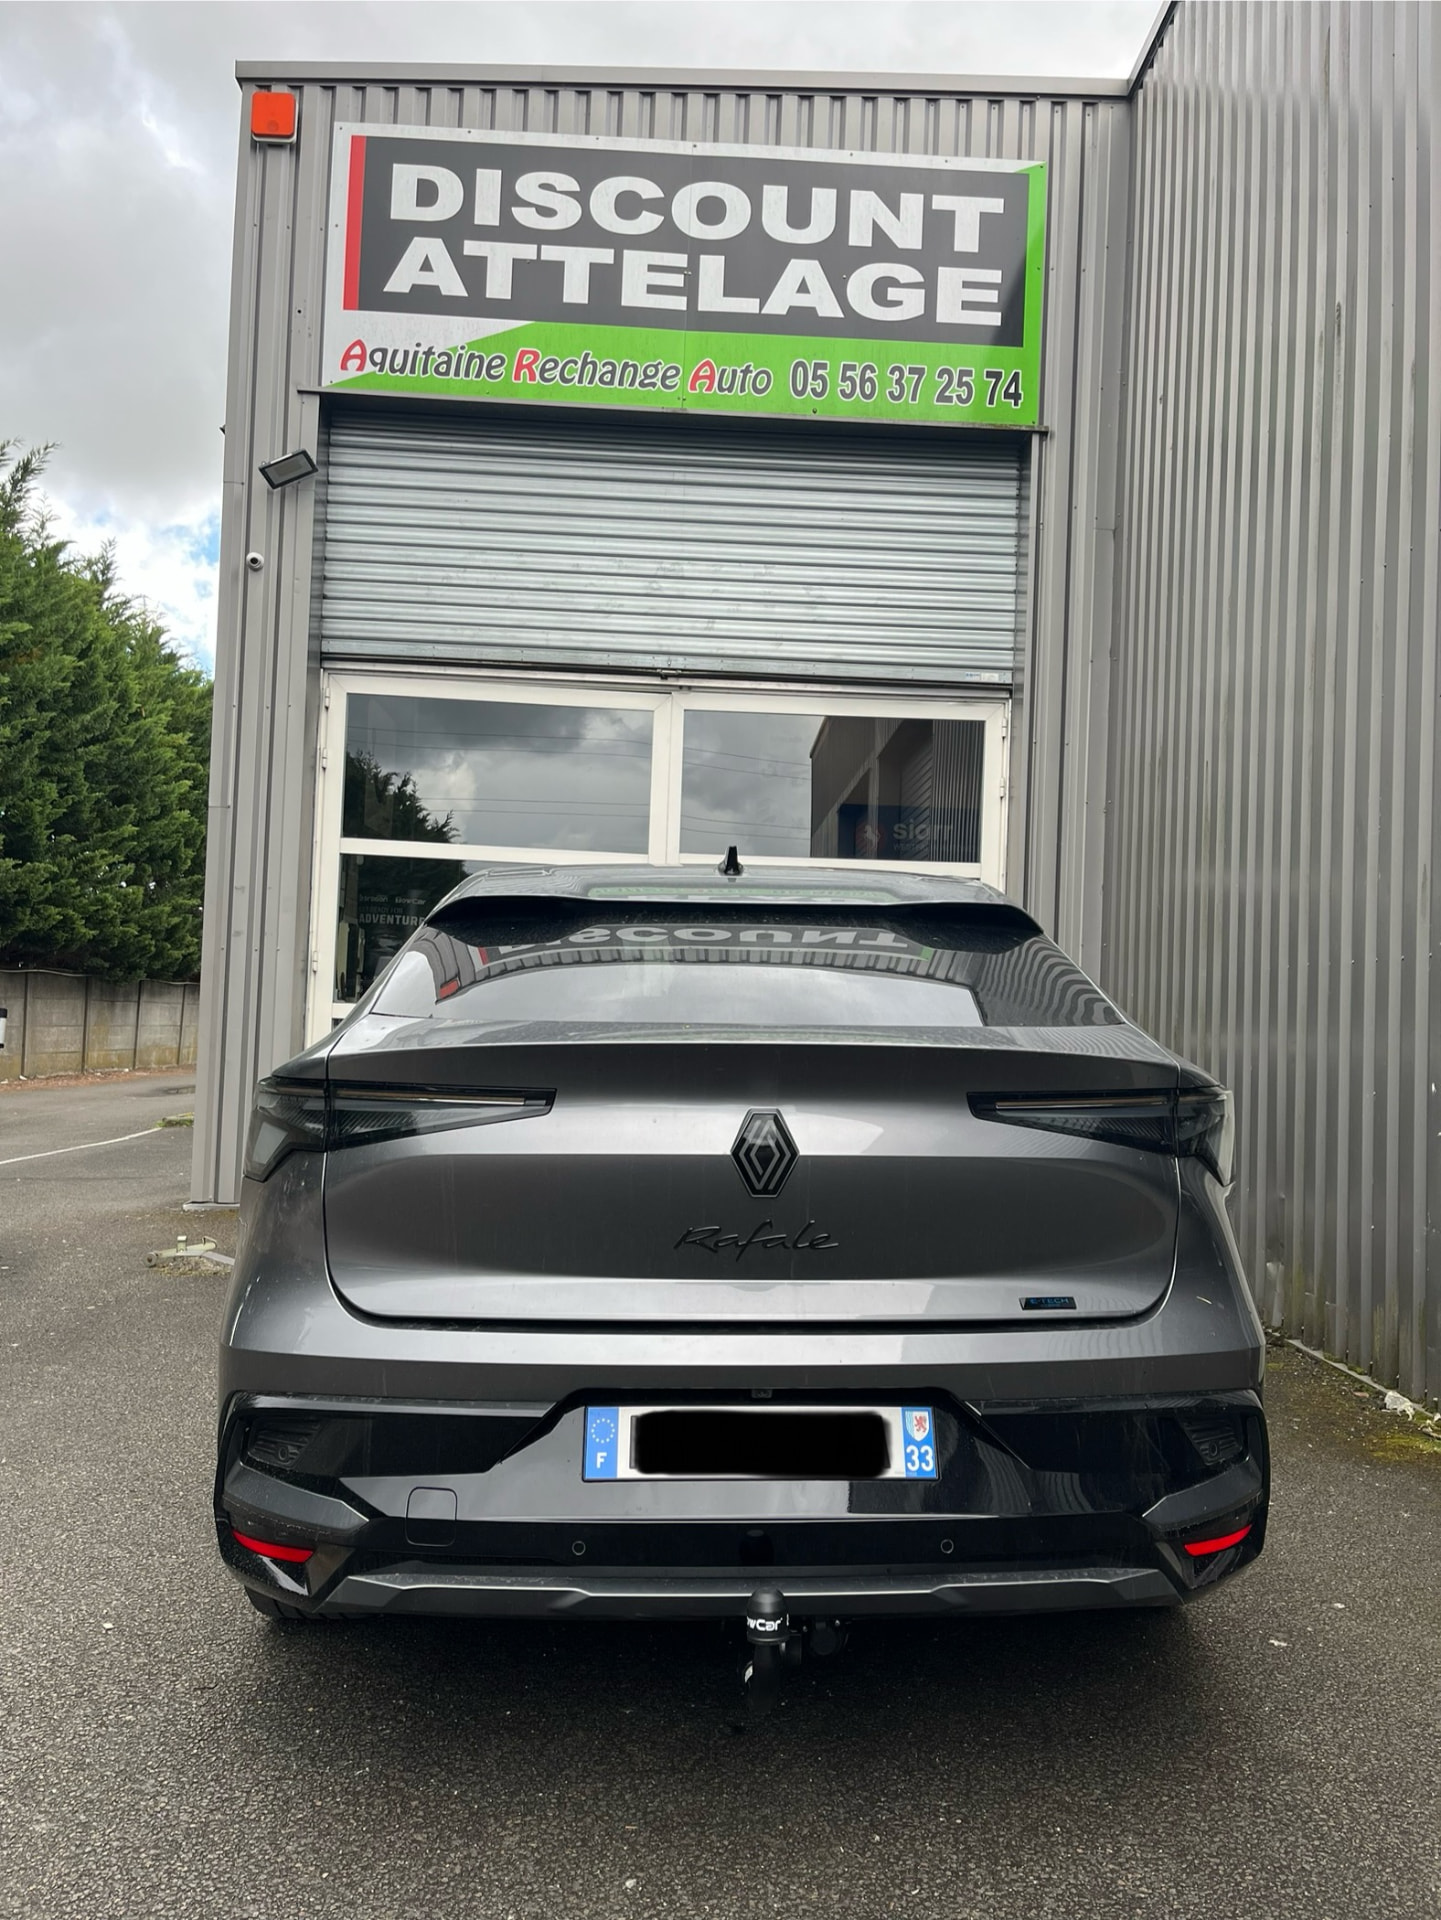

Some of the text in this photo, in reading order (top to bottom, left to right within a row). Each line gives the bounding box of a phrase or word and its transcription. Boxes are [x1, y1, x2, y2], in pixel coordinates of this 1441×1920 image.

[390, 163, 1004, 253] DISCOUNT
[383, 236, 1002, 326] ATTELAGE
[340, 338, 1023, 408] Aquitaine Rechange Auto 05 56 37 25 74
[673, 1219, 839, 1262] Rafale
[596, 1452, 607, 1469] F
[906, 1445, 934, 1471] 33
